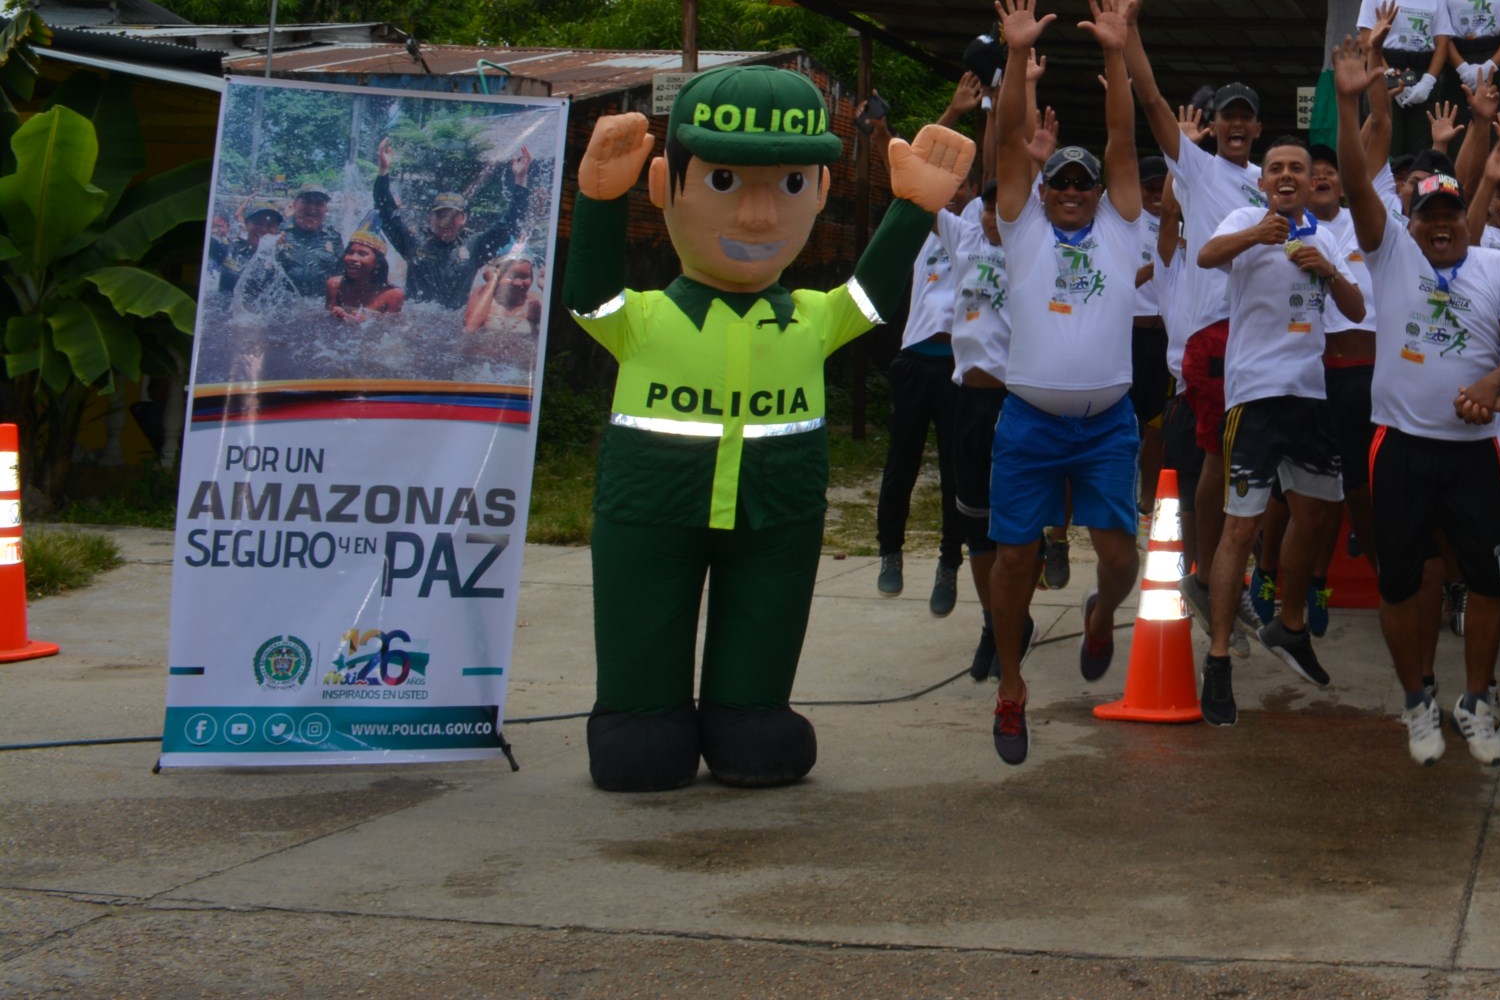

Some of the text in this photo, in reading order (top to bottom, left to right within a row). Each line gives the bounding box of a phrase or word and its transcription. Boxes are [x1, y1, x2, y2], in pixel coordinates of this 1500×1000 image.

[693, 103, 827, 136] POLICIA
[646, 382, 809, 418] POLICIA
[225, 446, 325, 473] POR UN
[187, 480, 516, 527] AMAZONAS
[185, 528, 336, 569] SEGURO
[354, 537, 377, 555] EN
[381, 531, 510, 599] PAZ
[340, 628, 411, 686] 126
[322, 689, 428, 700] INSPIRADOS EN USTED
[406, 677, 426, 686] AÑOS
[351, 721, 492, 736] WWW.POLICIA.GOV.CO
